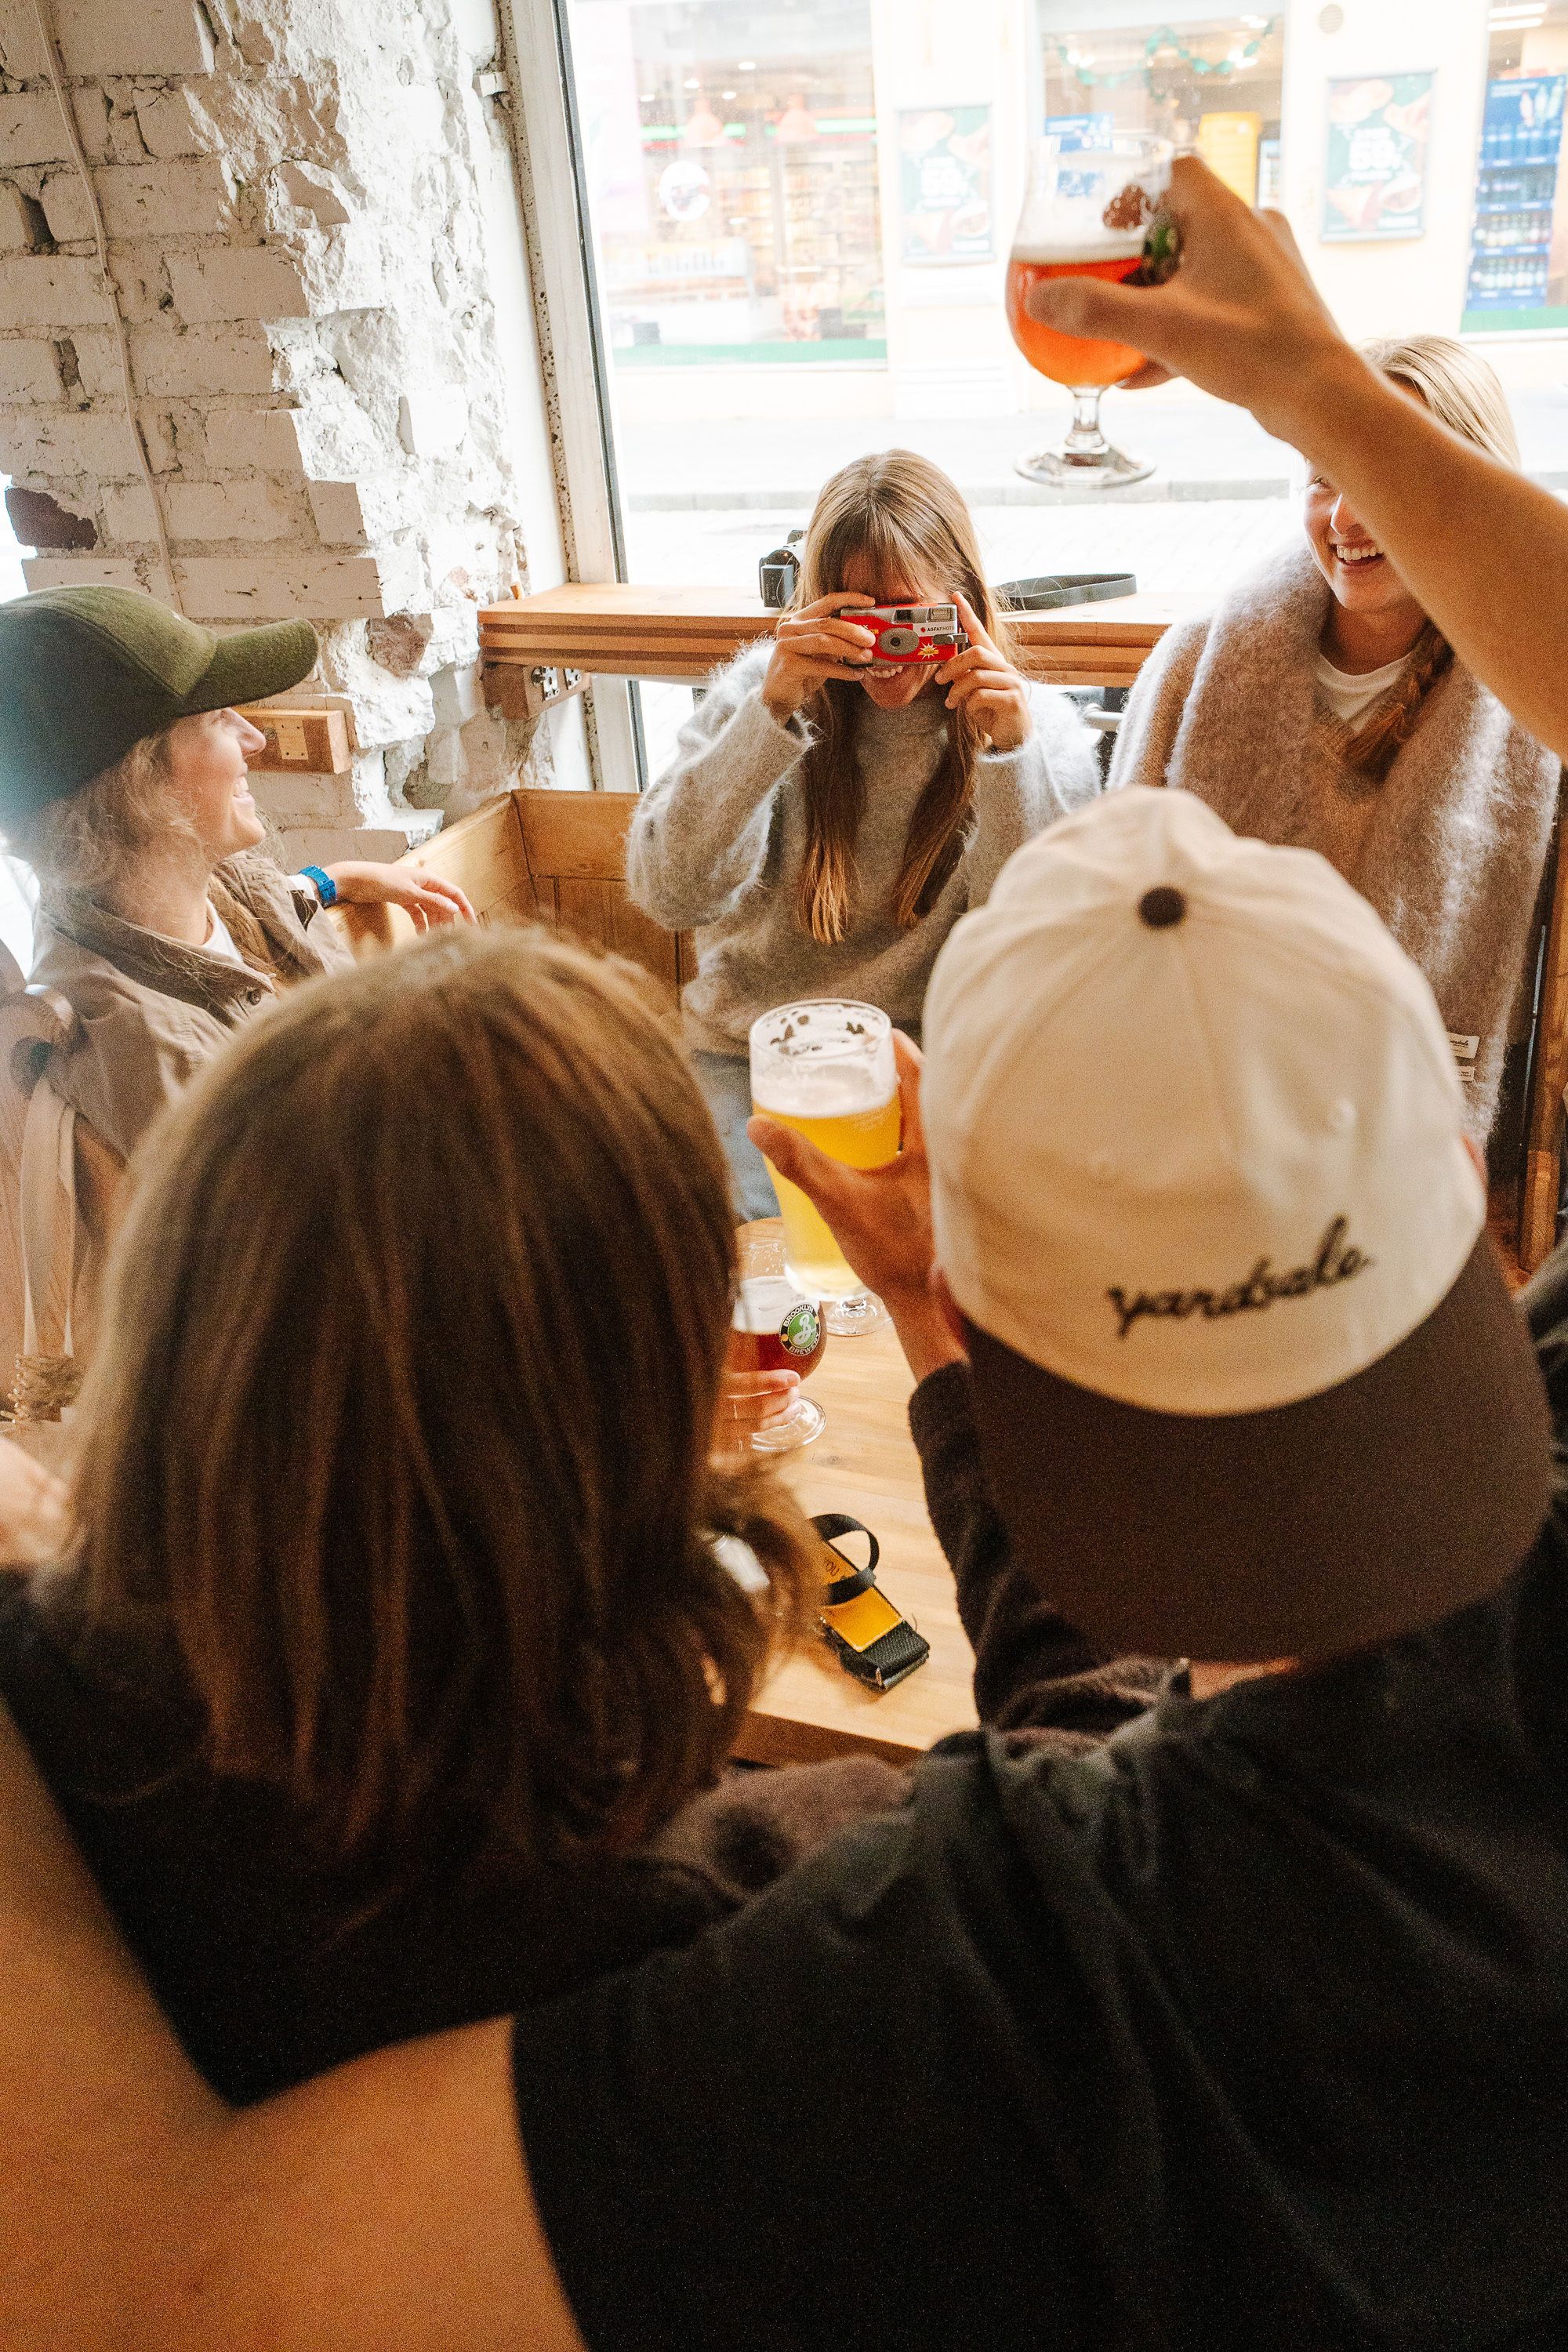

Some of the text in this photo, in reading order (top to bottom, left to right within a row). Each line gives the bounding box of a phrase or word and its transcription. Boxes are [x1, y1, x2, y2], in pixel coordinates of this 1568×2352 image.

[1107, 1213, 1372, 1339] yardsale
[783, 1305, 814, 1327] BROOKLYN
[789, 1332, 819, 1355] BREWERY
